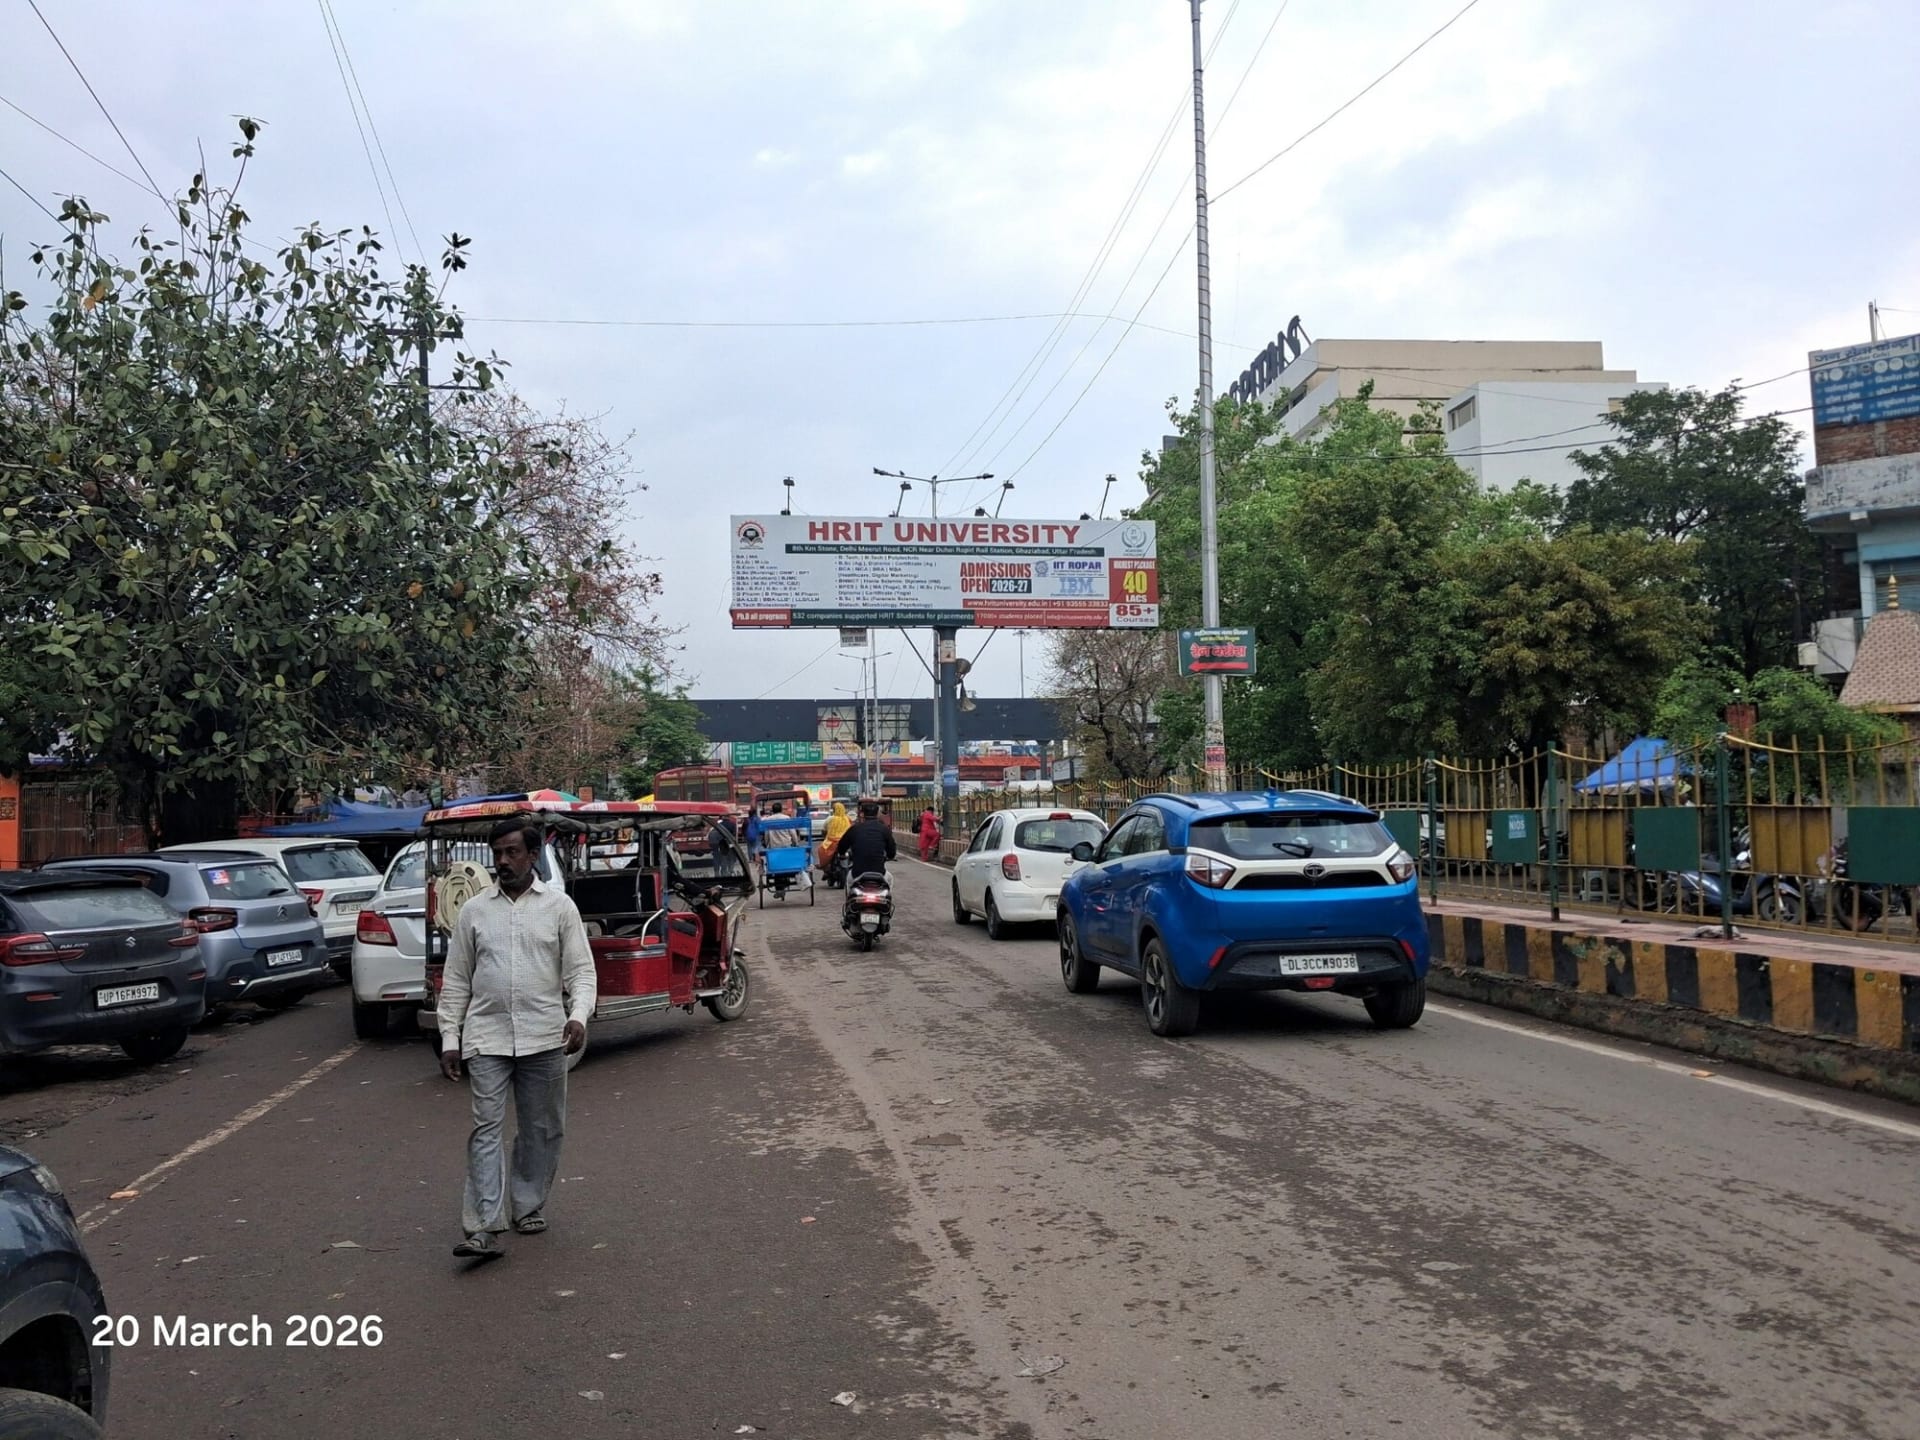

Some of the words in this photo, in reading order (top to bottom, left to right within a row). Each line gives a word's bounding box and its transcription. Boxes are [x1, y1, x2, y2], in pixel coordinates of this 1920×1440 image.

[809, 522, 882, 541] HRIT
[894, 522, 1081, 544] UNIVERSITY
[805, 545, 816, 553] Km
[903, 546, 917, 554] NCR
[919, 546, 934, 554] Near
[960, 563, 1032, 578] ADMISSIONS
[1053, 561, 1066, 570] IIT
[1068, 561, 1102, 570] ROPAR
[961, 578, 989, 593] OPEN
[991, 580, 1028, 592] 2026-27
[1060, 577, 1094, 593] IBM
[1122, 570, 1148, 594] 40
[1126, 594, 1148, 603] LACS
[807, 613, 843, 621] companies
[844, 612, 877, 621] supported
[936, 612, 974, 621] placements
[1115, 604, 1155, 617] 85+
[750, 613, 759, 622] all
[759, 613, 788, 622] programs
[1288, 957, 1356, 971] DL3CCM9038
